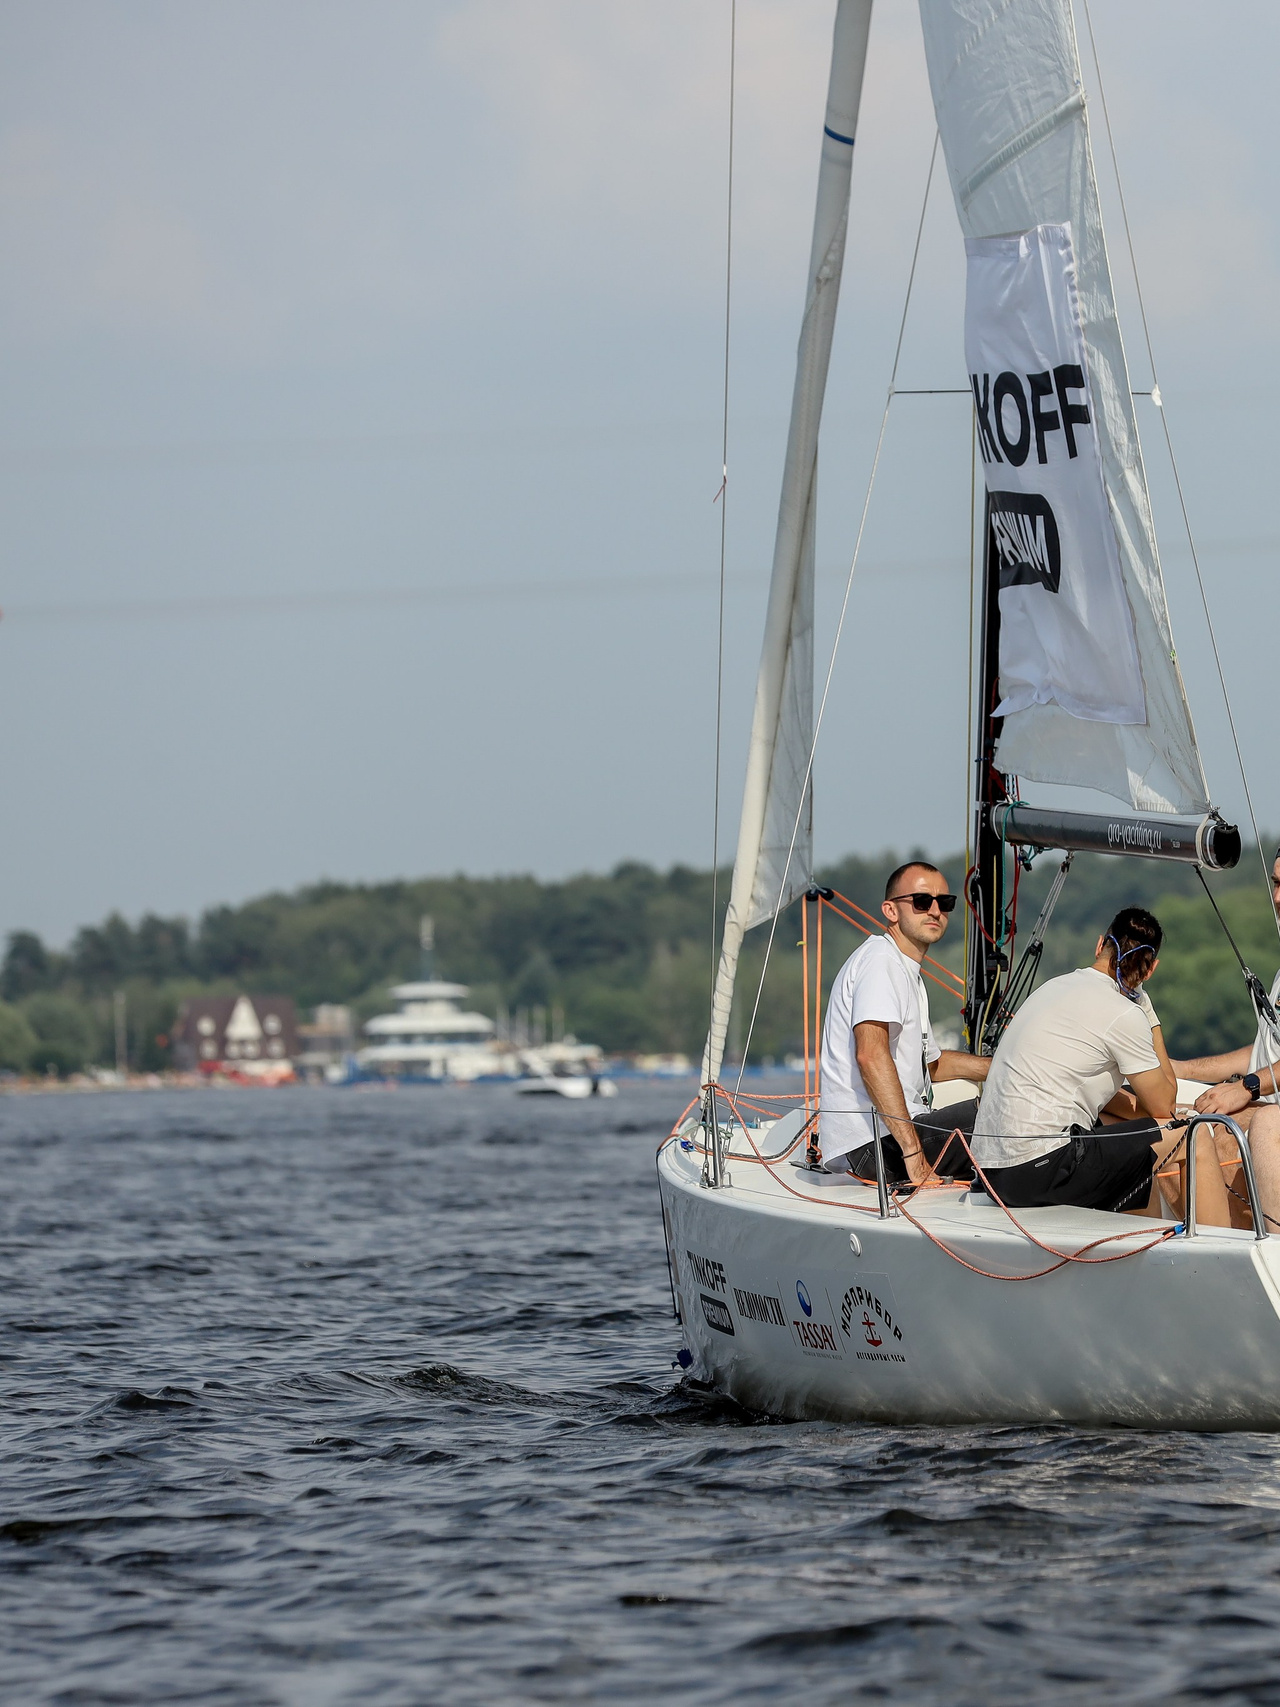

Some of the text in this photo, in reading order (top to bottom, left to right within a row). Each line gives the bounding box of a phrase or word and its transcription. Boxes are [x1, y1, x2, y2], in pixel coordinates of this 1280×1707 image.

[969, 364, 1091, 467] KOFF
[1108, 820, 1162, 854] pro-yachting.ru
[686, 1250, 727, 1294] TINKOFF
[733, 1287, 787, 1327] ВЕДОМОСТИ
[841, 1286, 903, 1341] МОРПРИБОР
[793, 1320, 838, 1352] TASSAY
